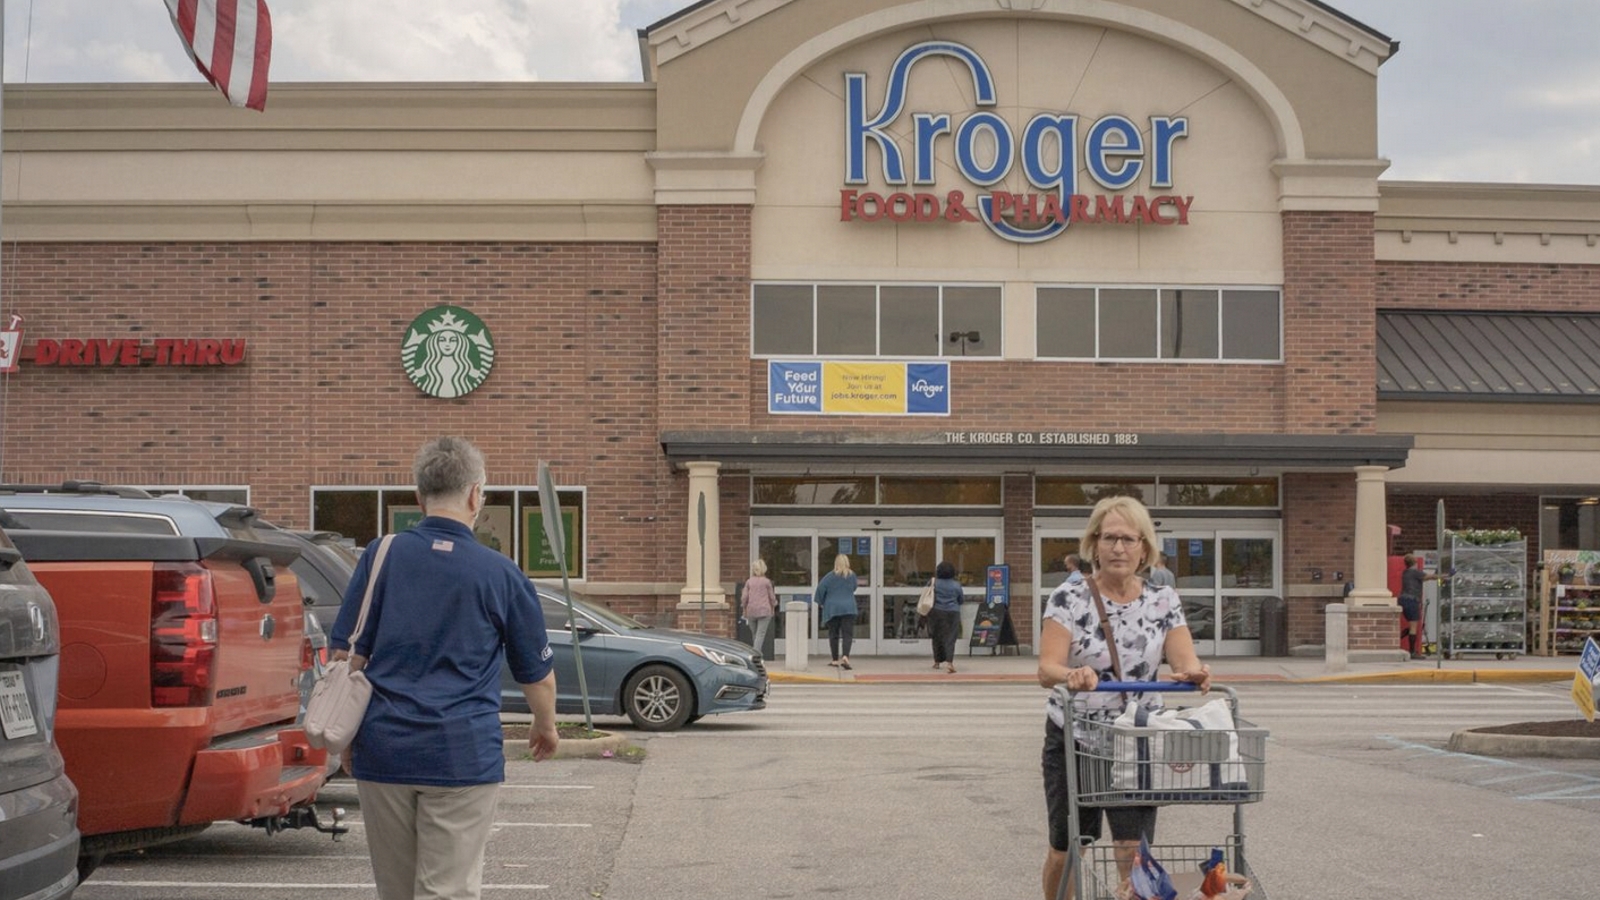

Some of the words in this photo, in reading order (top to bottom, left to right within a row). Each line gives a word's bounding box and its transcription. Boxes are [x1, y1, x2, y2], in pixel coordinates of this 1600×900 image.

[844, 40, 1189, 244] Kroger
[840, 189, 940, 222] FOOD
[988, 191, 1195, 225] PHARMACY
[784, 370, 817, 382] Feed
[787, 382, 817, 393] Your
[912, 379, 944, 398] Kroger
[774, 393, 817, 404] Future
[831, 392, 897, 400] jobs.kroger.com
[945, 432, 966, 444] THE
[970, 432, 1013, 444] KROGER
[1018, 432, 1035, 444] CO.
[1039, 433, 1110, 444] ESTABLISHED
[1114, 433, 1139, 445] 1883
